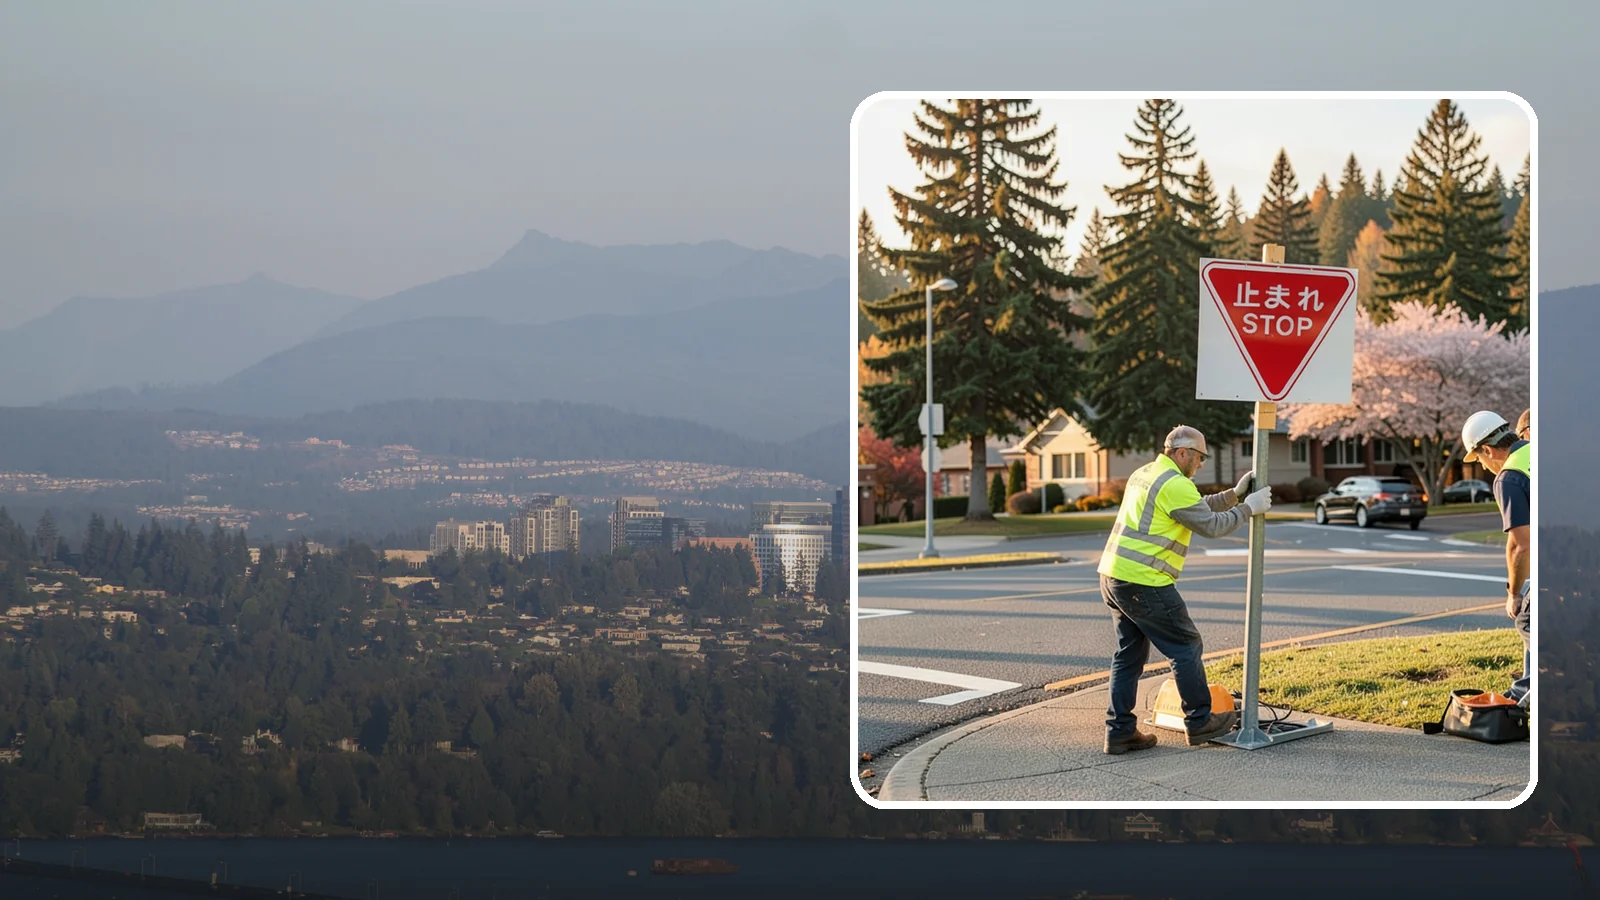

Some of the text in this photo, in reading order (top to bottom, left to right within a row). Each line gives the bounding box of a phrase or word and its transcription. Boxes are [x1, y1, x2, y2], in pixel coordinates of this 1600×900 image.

[1233, 281, 1324, 312] 止まれ
[1242, 313, 1313, 336] STOP
